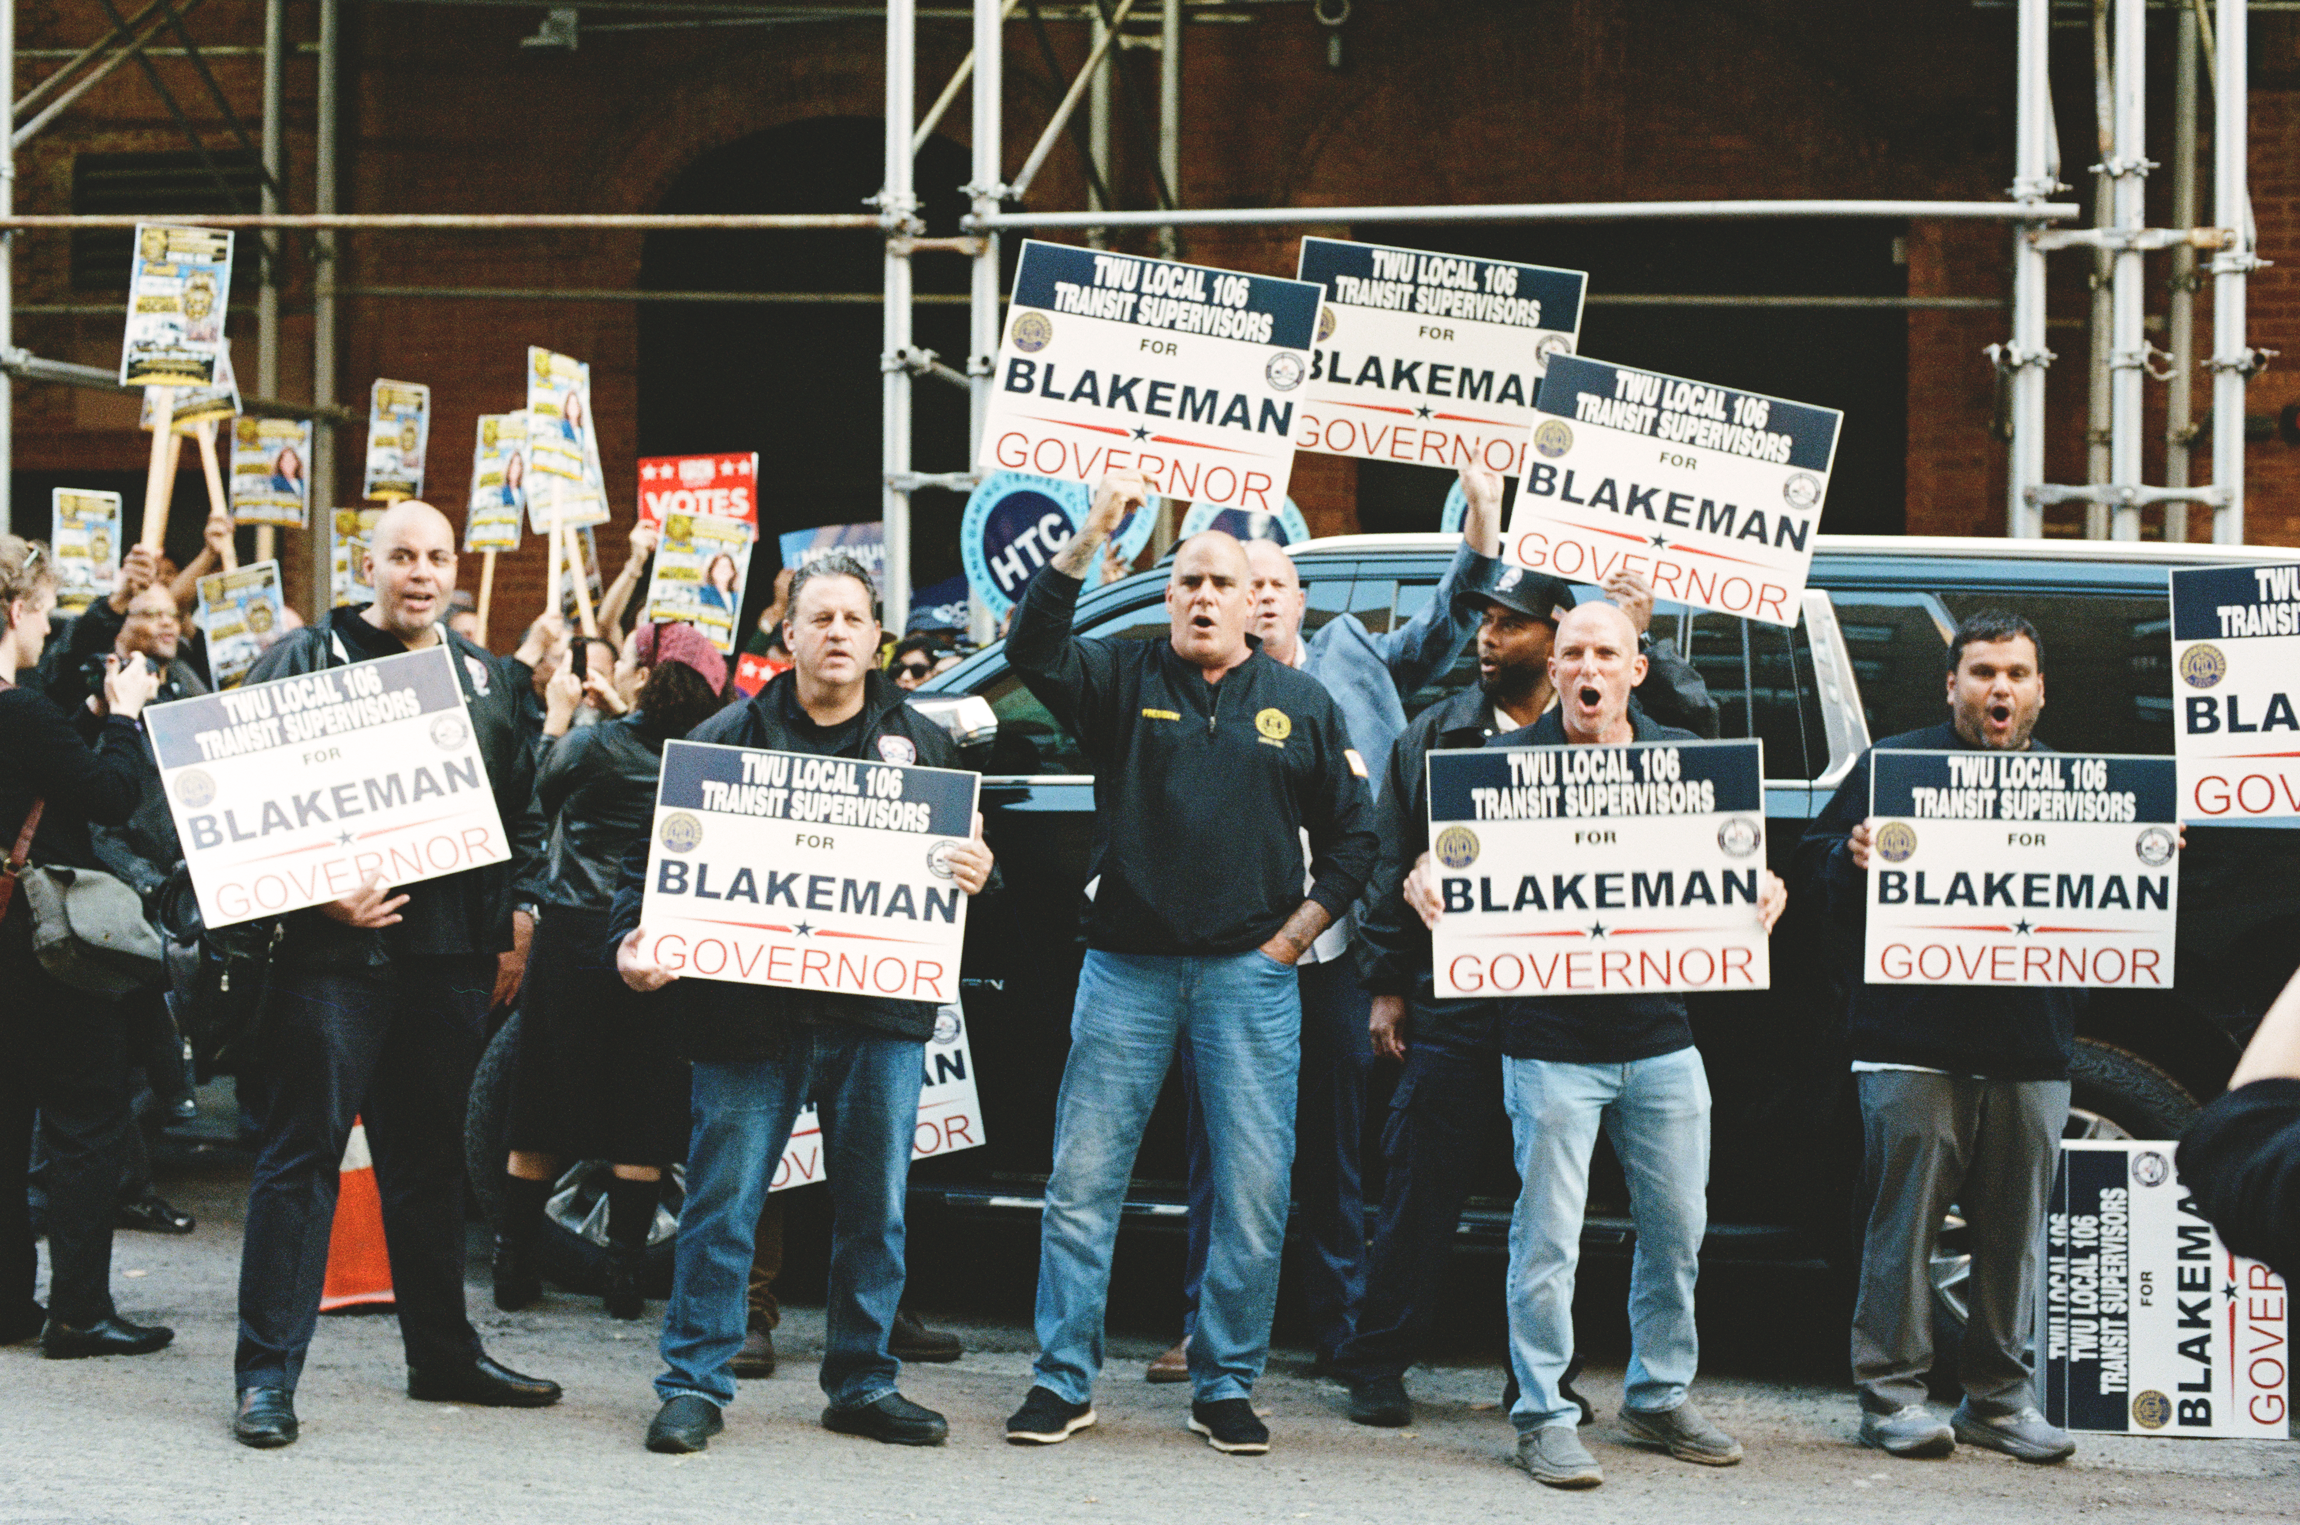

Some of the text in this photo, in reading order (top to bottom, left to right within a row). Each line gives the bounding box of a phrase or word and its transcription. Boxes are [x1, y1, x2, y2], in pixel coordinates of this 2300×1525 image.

[1094, 256, 1250, 308] TWU LOCAL 106
[1372, 249, 1518, 296] TWU LOCAL 106
[1054, 281, 1273, 344] TRANSIT SUPERVISORS
[1335, 275, 1541, 327] TRANSIT SUPERVISORS
[1139, 338, 1178, 357] FOR
[1419, 325, 1455, 341] FOR
[1004, 356, 1294, 437] BLAKEMAN
[1615, 369, 1770, 430] TWU LOCAL 106
[1295, 414, 1528, 474] GOVERNO
[1576, 392, 1793, 464] TRANSIT SUPERVISORS
[1659, 451, 1698, 471] FOR
[644, 487, 750, 520] VOTES
[1526, 461, 1811, 553] BLAKEMAN
[990, 513, 1070, 592] HTC
[2217, 602, 2300, 637] TRANSI
[220, 665, 383, 726] TWU LOCAL 106
[2185, 692, 2300, 735] BLA
[195, 687, 421, 762] TRANSIT SUPERVISORS
[302, 747, 342, 766] FOR
[741, 752, 904, 799] TWU LOCAL 106
[1507, 747, 1680, 786] TWU LOCAL 106
[1948, 756, 2107, 792] TWU LOCAL 106
[187, 755, 481, 851] BLAKEMAN
[701, 780, 931, 833] TRANSIT SUPERVISORS
[1471, 780, 1715, 820] TRANSIT SUPERVISORS
[1912, 787, 2136, 823] TRANSIT SUPERVISORS
[795, 833, 835, 850] FOR
[1575, 830, 1617, 845] FOR
[2007, 833, 2046, 847] FOR
[215, 826, 497, 918] GOVERNOR
[657, 858, 960, 925] BLAKEMAN
[1442, 867, 1758, 914] BLAKEMAN
[1878, 870, 2169, 911] BLAKEMAN
[653, 934, 944, 999] GOVERNOR
[1449, 947, 1756, 993] GOVERNOR
[1880, 943, 2161, 985] GOVERNOR
[2070, 1214, 2099, 1362] TWU LOCAL 106
[2100, 1187, 2127, 1395] TRANSIT SUPERVISORS
[2140, 1270, 2153, 1307] FOR
[2177, 1195, 2212, 1427] BLAKEMA
